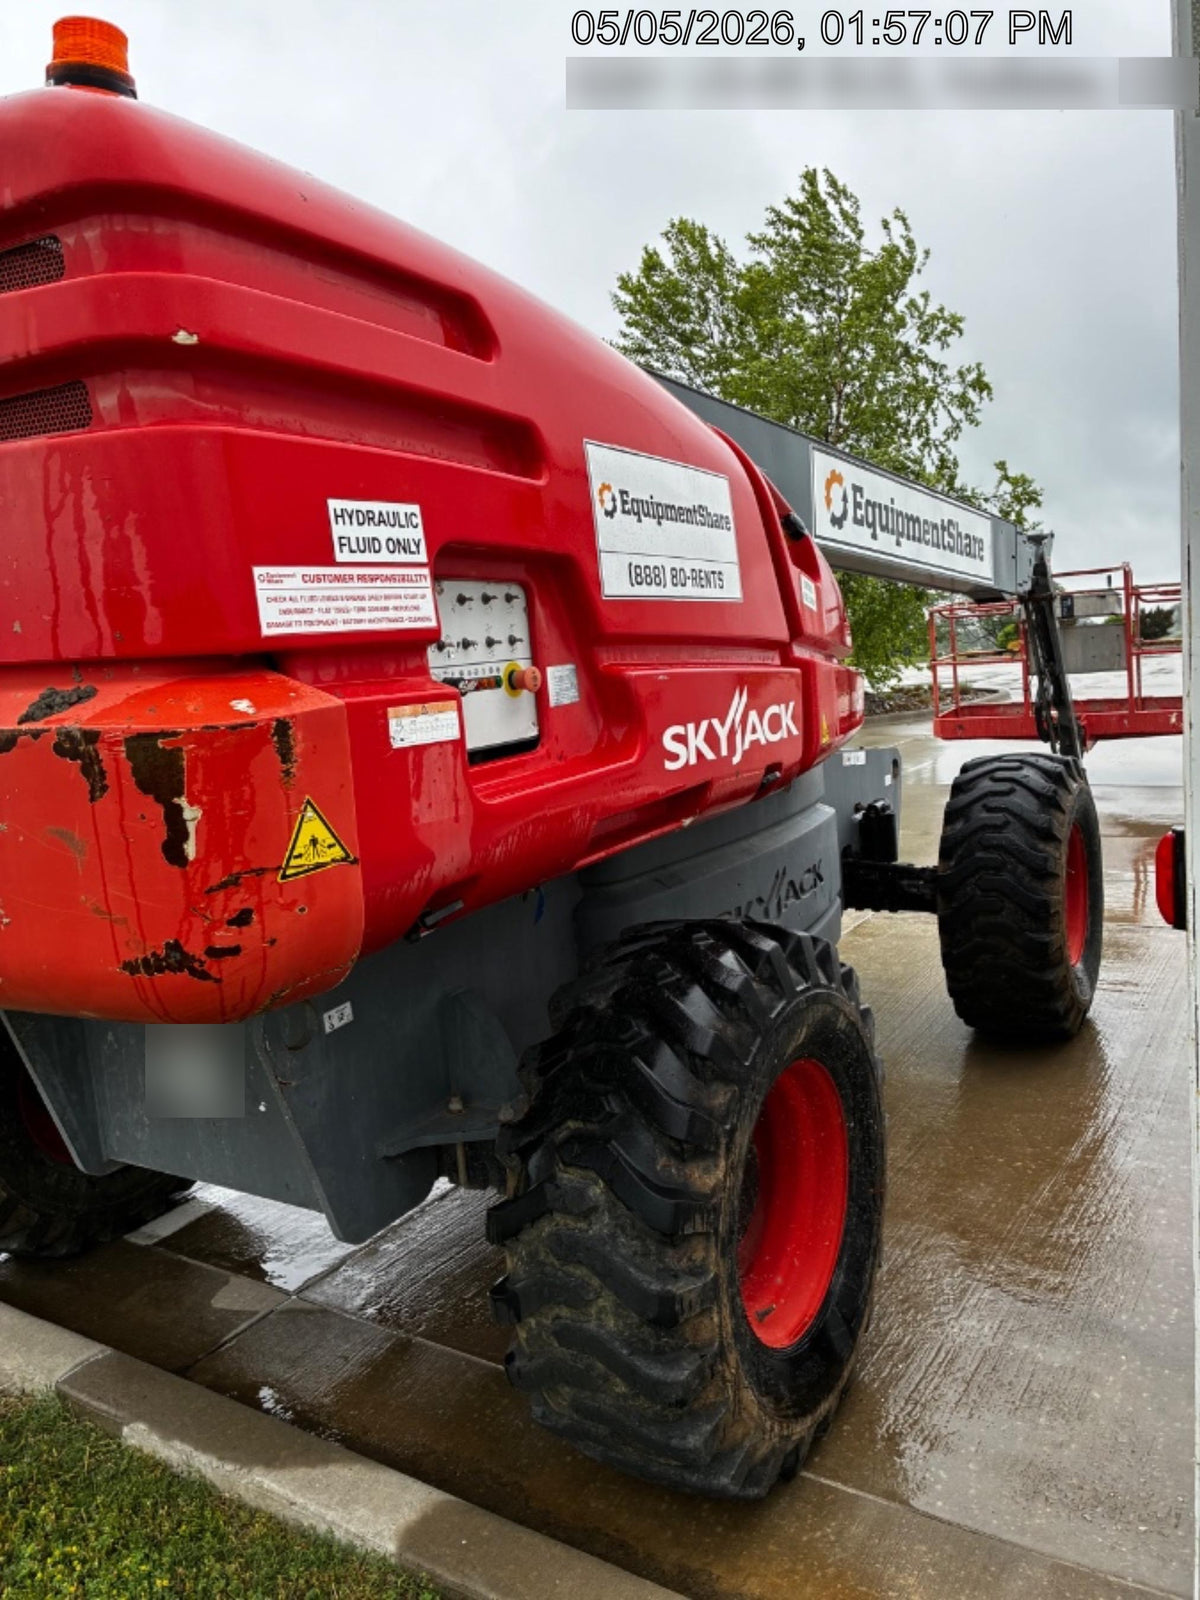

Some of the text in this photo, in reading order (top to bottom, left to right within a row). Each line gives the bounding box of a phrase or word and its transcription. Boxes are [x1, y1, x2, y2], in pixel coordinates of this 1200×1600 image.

[333, 507, 419, 529] HYDRAULIC
[618, 488, 732, 532] EquipmentShare
[851, 482, 985, 563] EquipmentShare
[338, 536, 422, 555] FLUID ONLY
[301, 573, 428, 584] CUSTOMER RESPONSIBILITY
[628, 561, 724, 590] (888) 80-RENTS
[662, 685, 800, 771] SKYJACK
[716, 858, 825, 920] KYJACK
